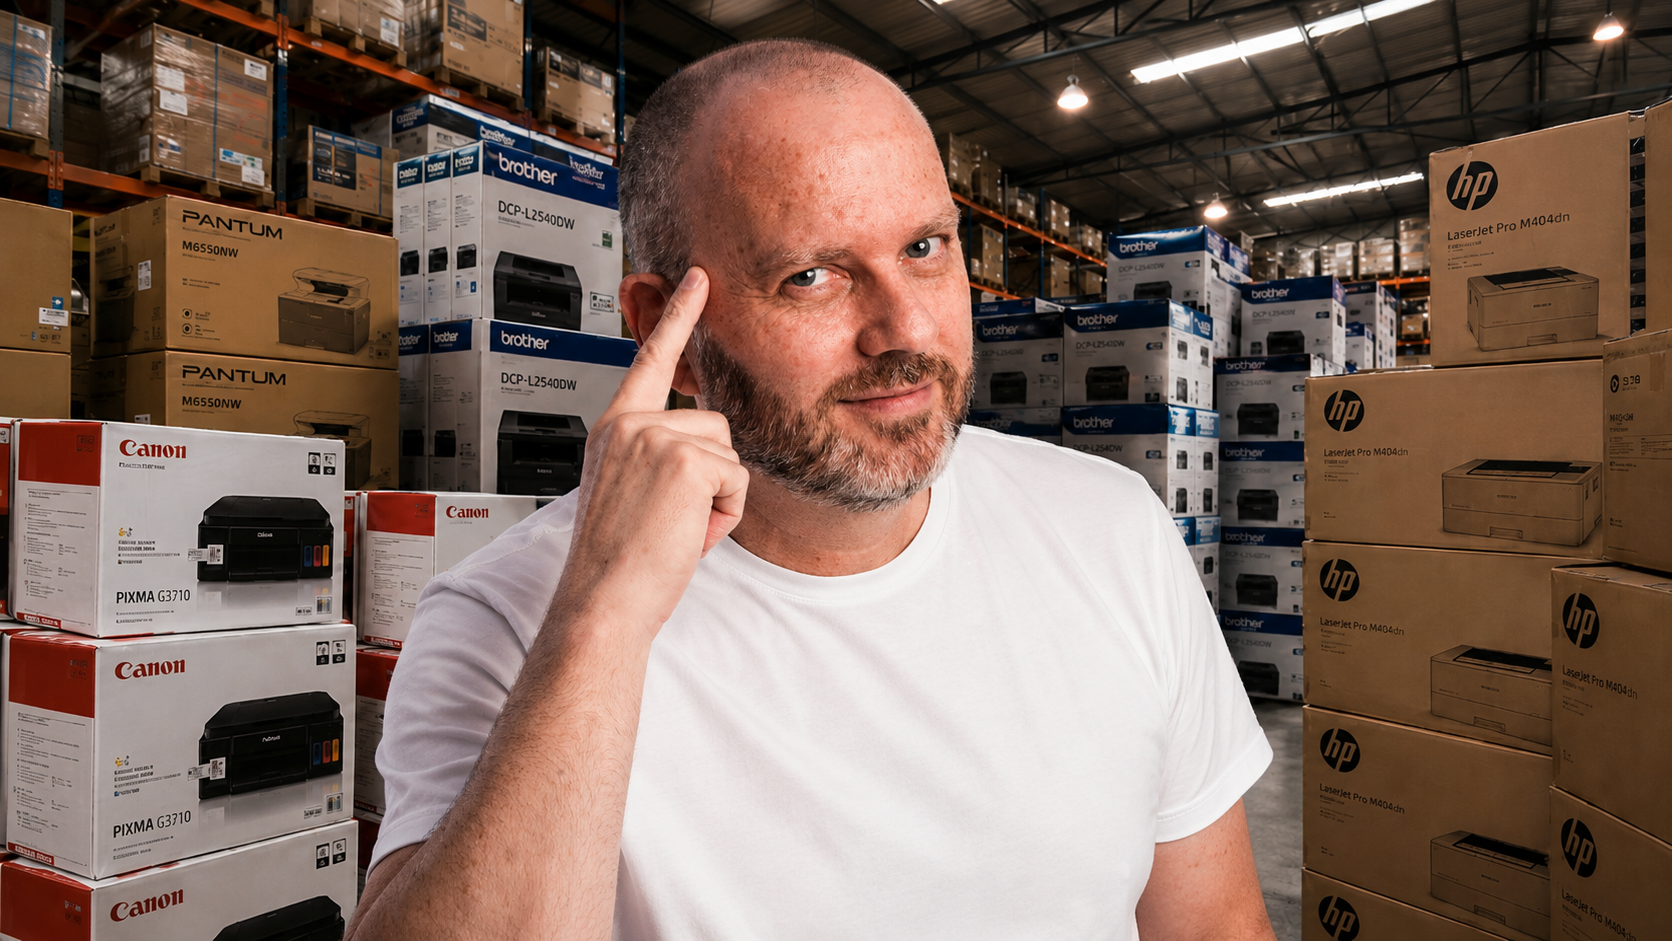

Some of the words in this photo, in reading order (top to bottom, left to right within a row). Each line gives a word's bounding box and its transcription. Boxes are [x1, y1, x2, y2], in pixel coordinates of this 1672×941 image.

[498, 152, 558, 186] brother
[1446, 160, 1499, 211] hp
[182, 209, 283, 240] PANTUM
[498, 200, 576, 231] DCP-L2540DW
[1447, 225, 1494, 241] LaserJet
[1496, 221, 1517, 234] Pro
[1520, 212, 1571, 231] M404dn
[182, 240, 239, 258] M6550NW
[1119, 240, 1159, 254] brother
[1251, 288, 1290, 299] brother
[982, 324, 1019, 336] brother
[1077, 313, 1119, 326] brother
[501, 330, 549, 351] brother
[182, 365, 286, 386] PANTUM
[501, 372, 577, 391] DCP-L2540DW
[182, 396, 242, 409] M6550NW
[1324, 389, 1365, 432] hp
[1073, 416, 1114, 428] brother
[119, 439, 187, 459] Canon
[1324, 448, 1356, 457] LaserJet
[1357, 447, 1371, 457] Pro
[1373, 447, 1409, 457] M404dn
[446, 505, 489, 518] Canon
[1319, 558, 1360, 602] hp
[116, 591, 155, 604] PIXMA
[157, 589, 191, 602] G3710
[1320, 616, 1352, 630] LaserJet
[1353, 621, 1368, 631] Pro
[1369, 622, 1405, 636] M404dn
[1562, 592, 1600, 649] hp
[115, 659, 186, 680] Canon
[1591, 674, 1605, 688] Pro
[1606, 679, 1638, 700] M404dn
[1319, 728, 1361, 773] hp
[1319, 783, 1352, 800] LaserJet
[1353, 792, 1368, 804] Pro
[1369, 797, 1405, 815] M404dn
[113, 818, 154, 838] PIXMA
[156, 810, 192, 829] G3710
[1561, 818, 1598, 878] hp
[110, 888, 184, 922] Canon
[1590, 906, 1603, 924] Pro
[1318, 895, 1360, 941] hp
